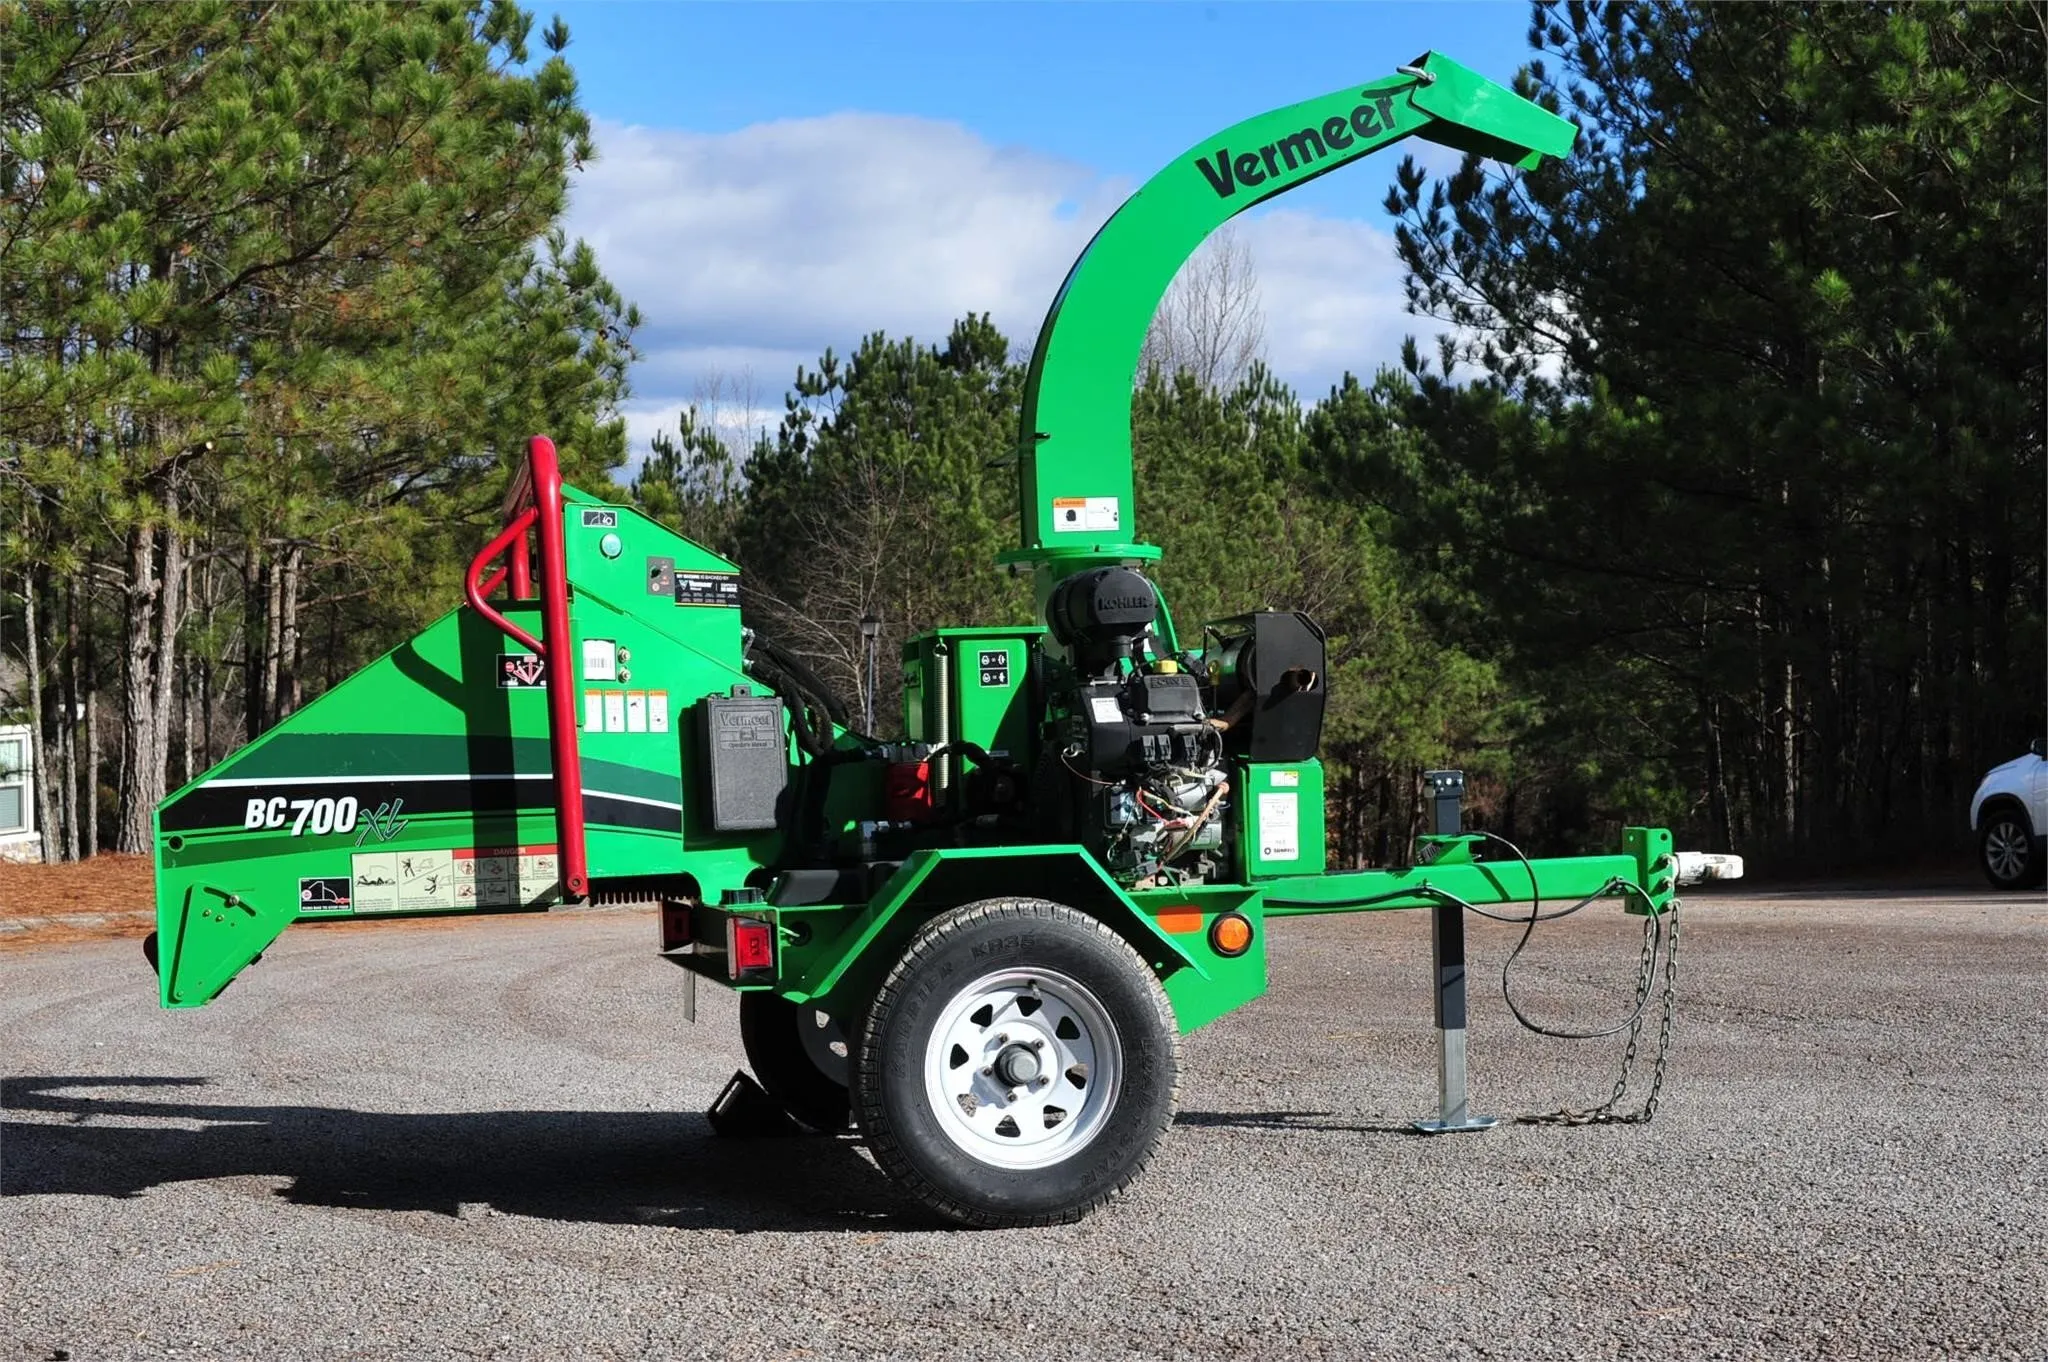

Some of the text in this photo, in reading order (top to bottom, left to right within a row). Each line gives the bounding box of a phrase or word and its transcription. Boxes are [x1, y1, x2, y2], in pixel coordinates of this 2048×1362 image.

[1195, 94, 1398, 199] Vermeer
[1098, 596, 1152, 611] KOHLER
[720, 712, 770, 726] Vermeer
[355, 798, 409, 847] XL
